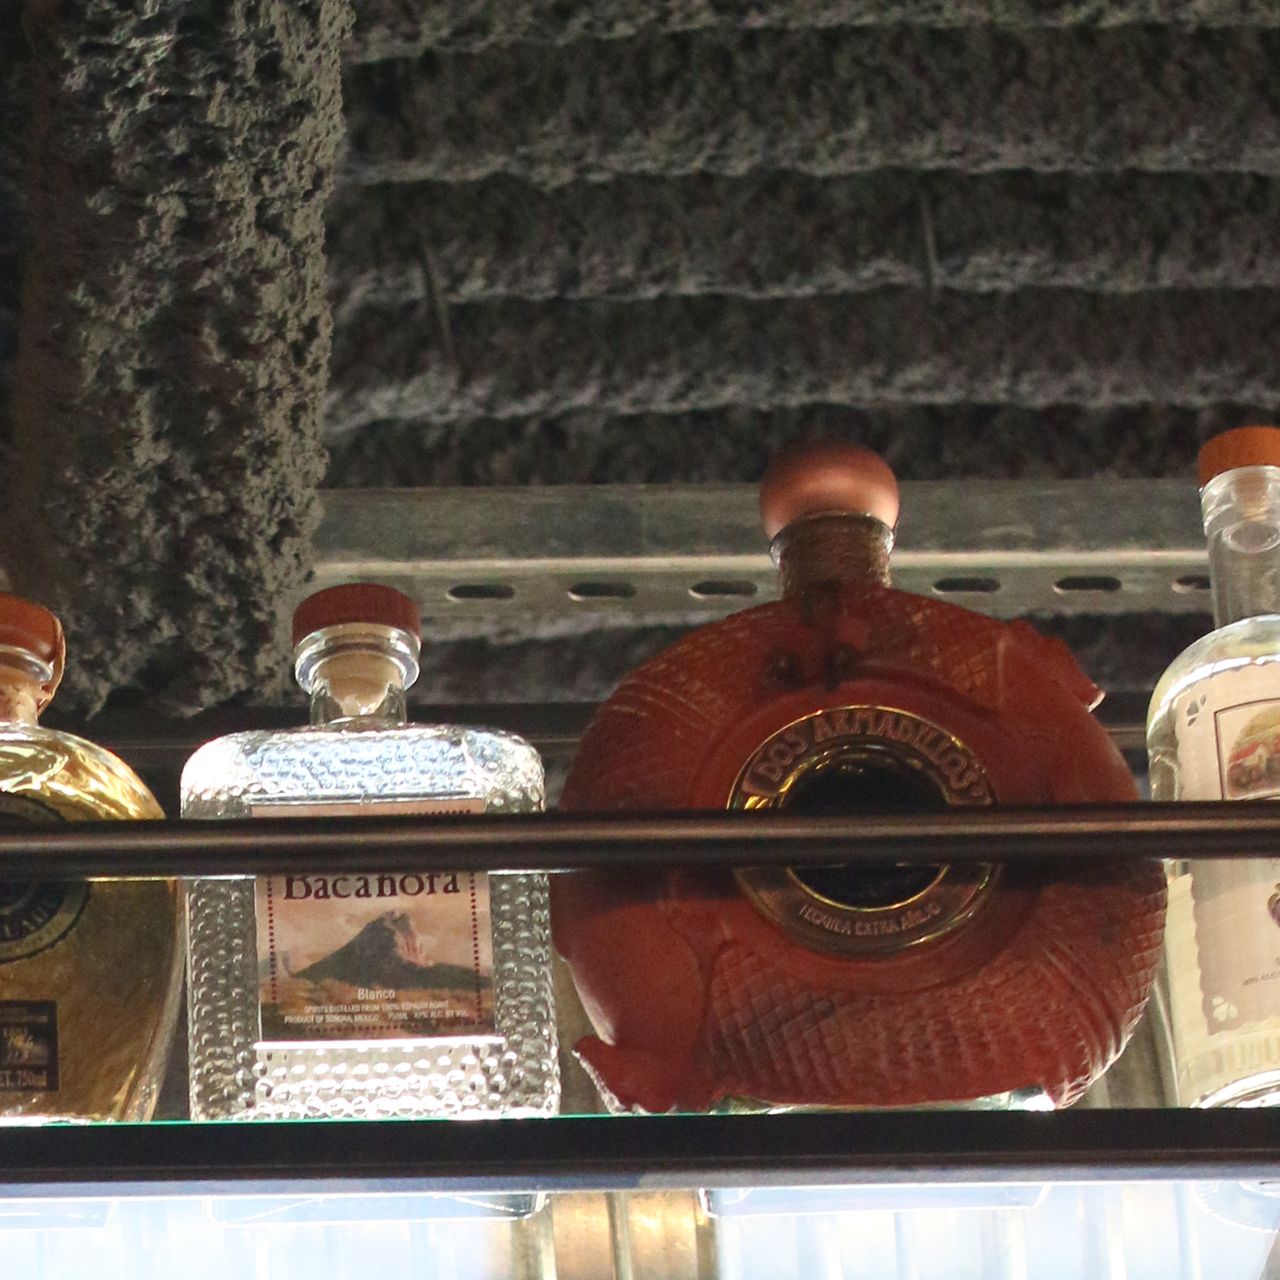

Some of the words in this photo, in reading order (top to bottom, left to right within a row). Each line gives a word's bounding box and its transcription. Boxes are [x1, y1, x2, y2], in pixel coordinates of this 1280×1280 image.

[754, 728, 808, 785] DOS
[812, 708, 980, 792] ARMADILLOS
[283, 872, 461, 901] Bacanora
[798, 903, 851, 936] TEQUILA
[854, 920, 898, 936] EXTRA
[357, 988, 396, 1000] Blanco
